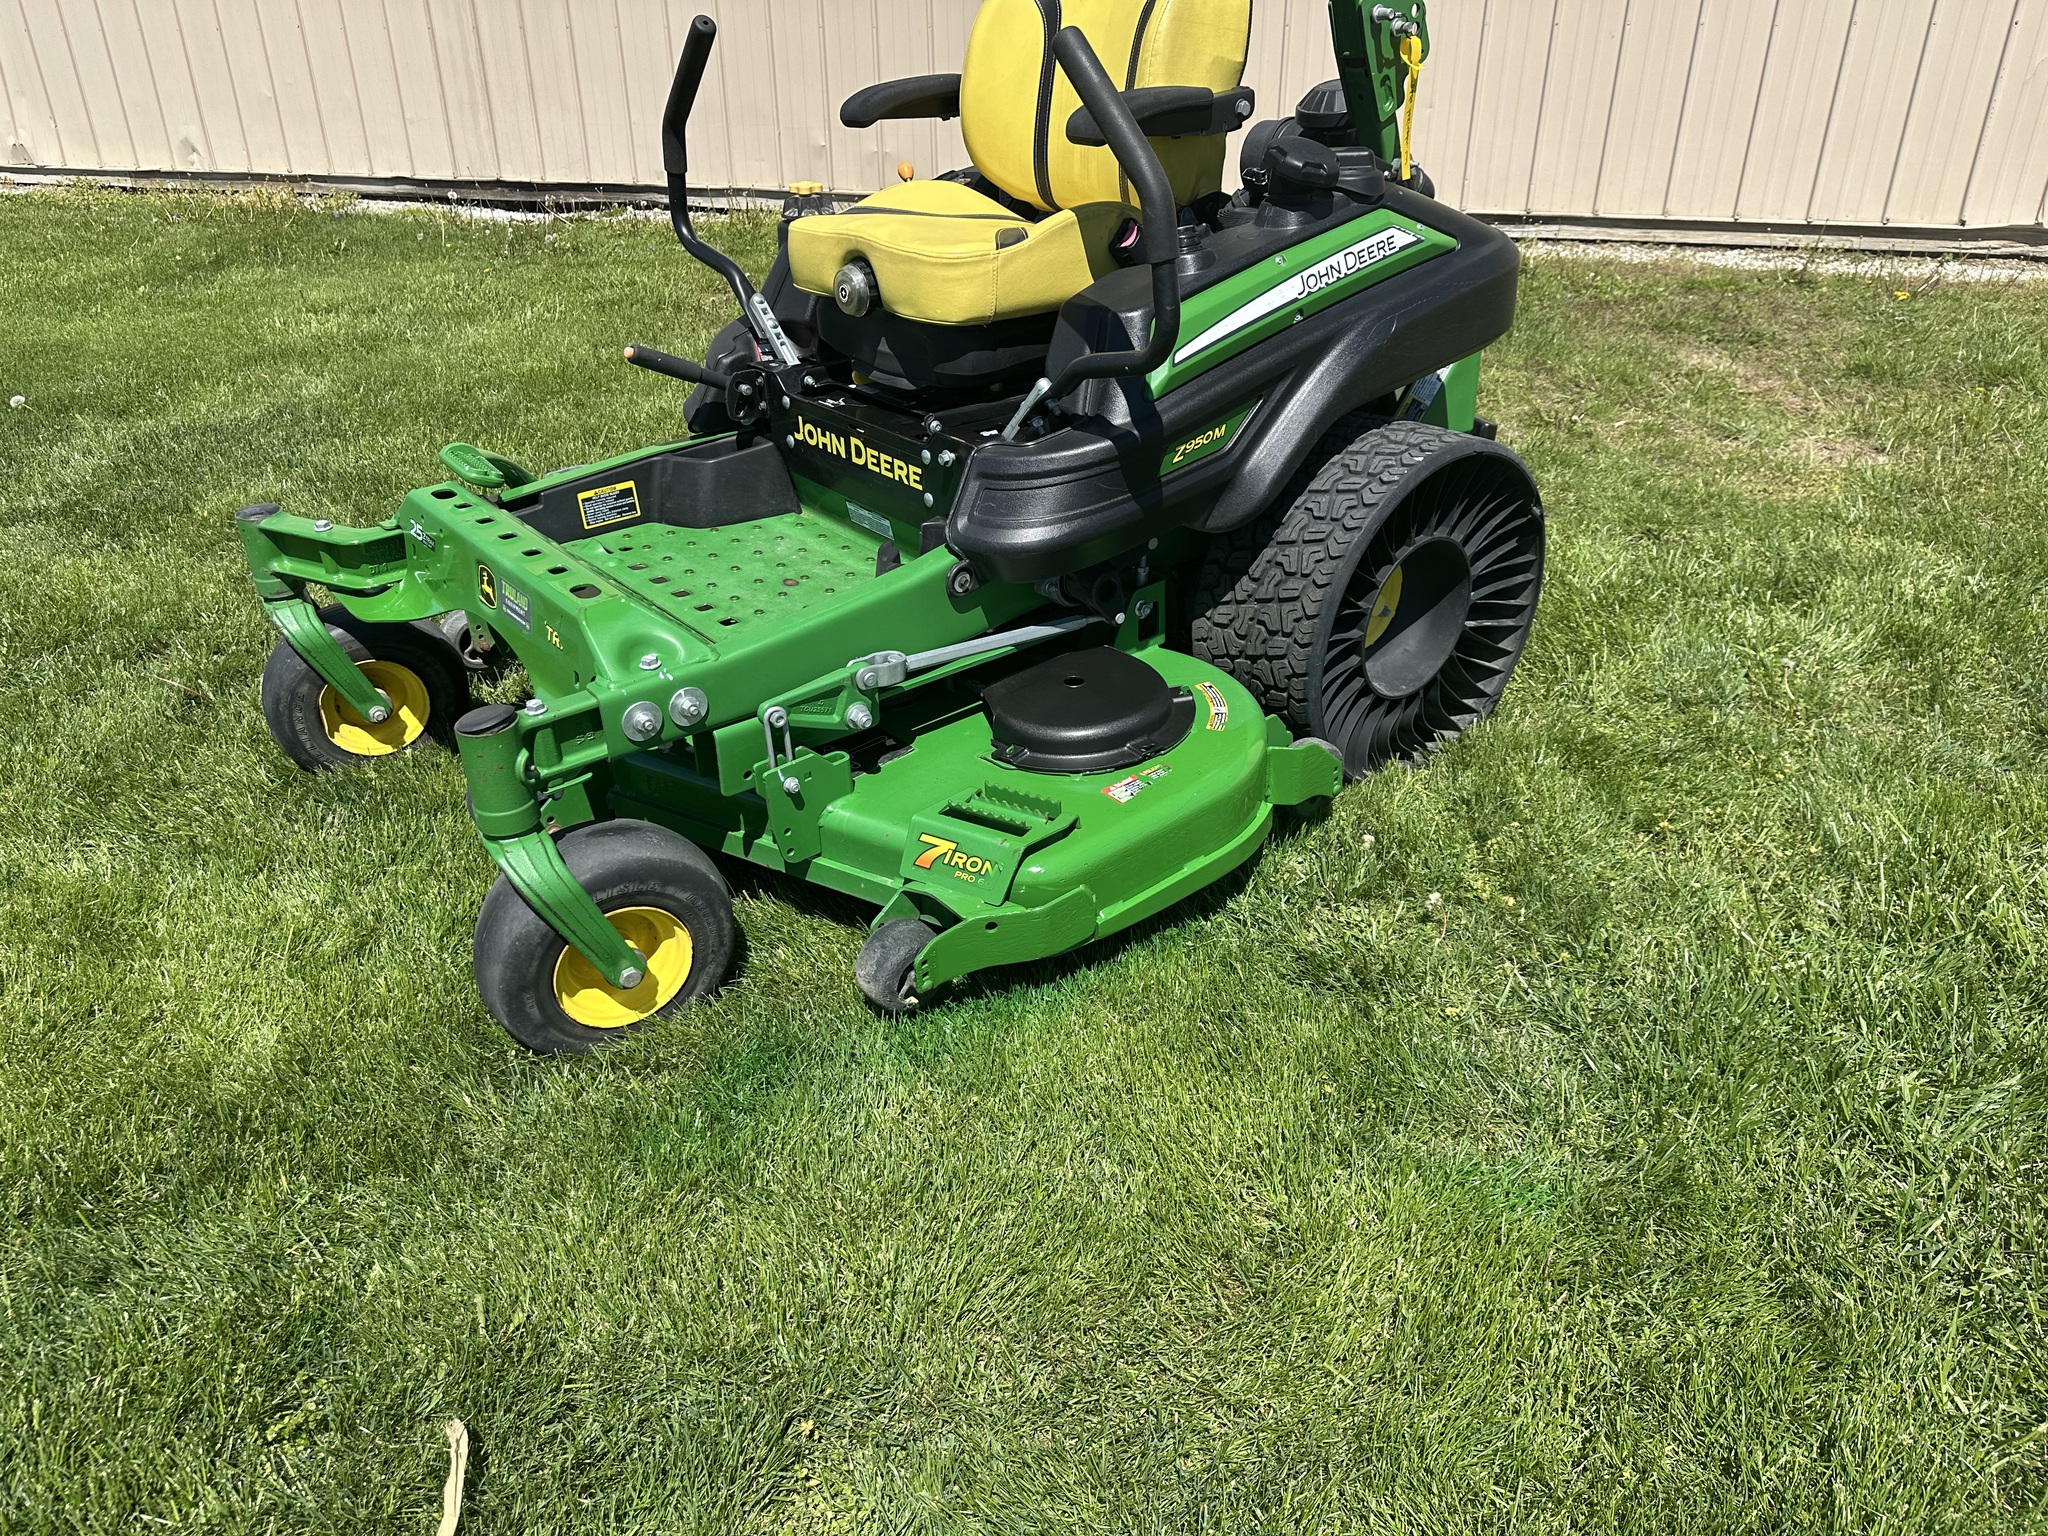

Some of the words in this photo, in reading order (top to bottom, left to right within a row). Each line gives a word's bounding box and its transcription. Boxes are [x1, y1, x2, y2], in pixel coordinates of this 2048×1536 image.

[1298, 260, 1342, 296] JOHN
[1344, 235, 1397, 271] DEERE
[794, 415, 846, 459] JOHN
[850, 436, 923, 491] DEERE
[1172, 423, 1227, 464] Z950M
[410, 518, 423, 541] 25
[954, 871, 976, 883] PRO
